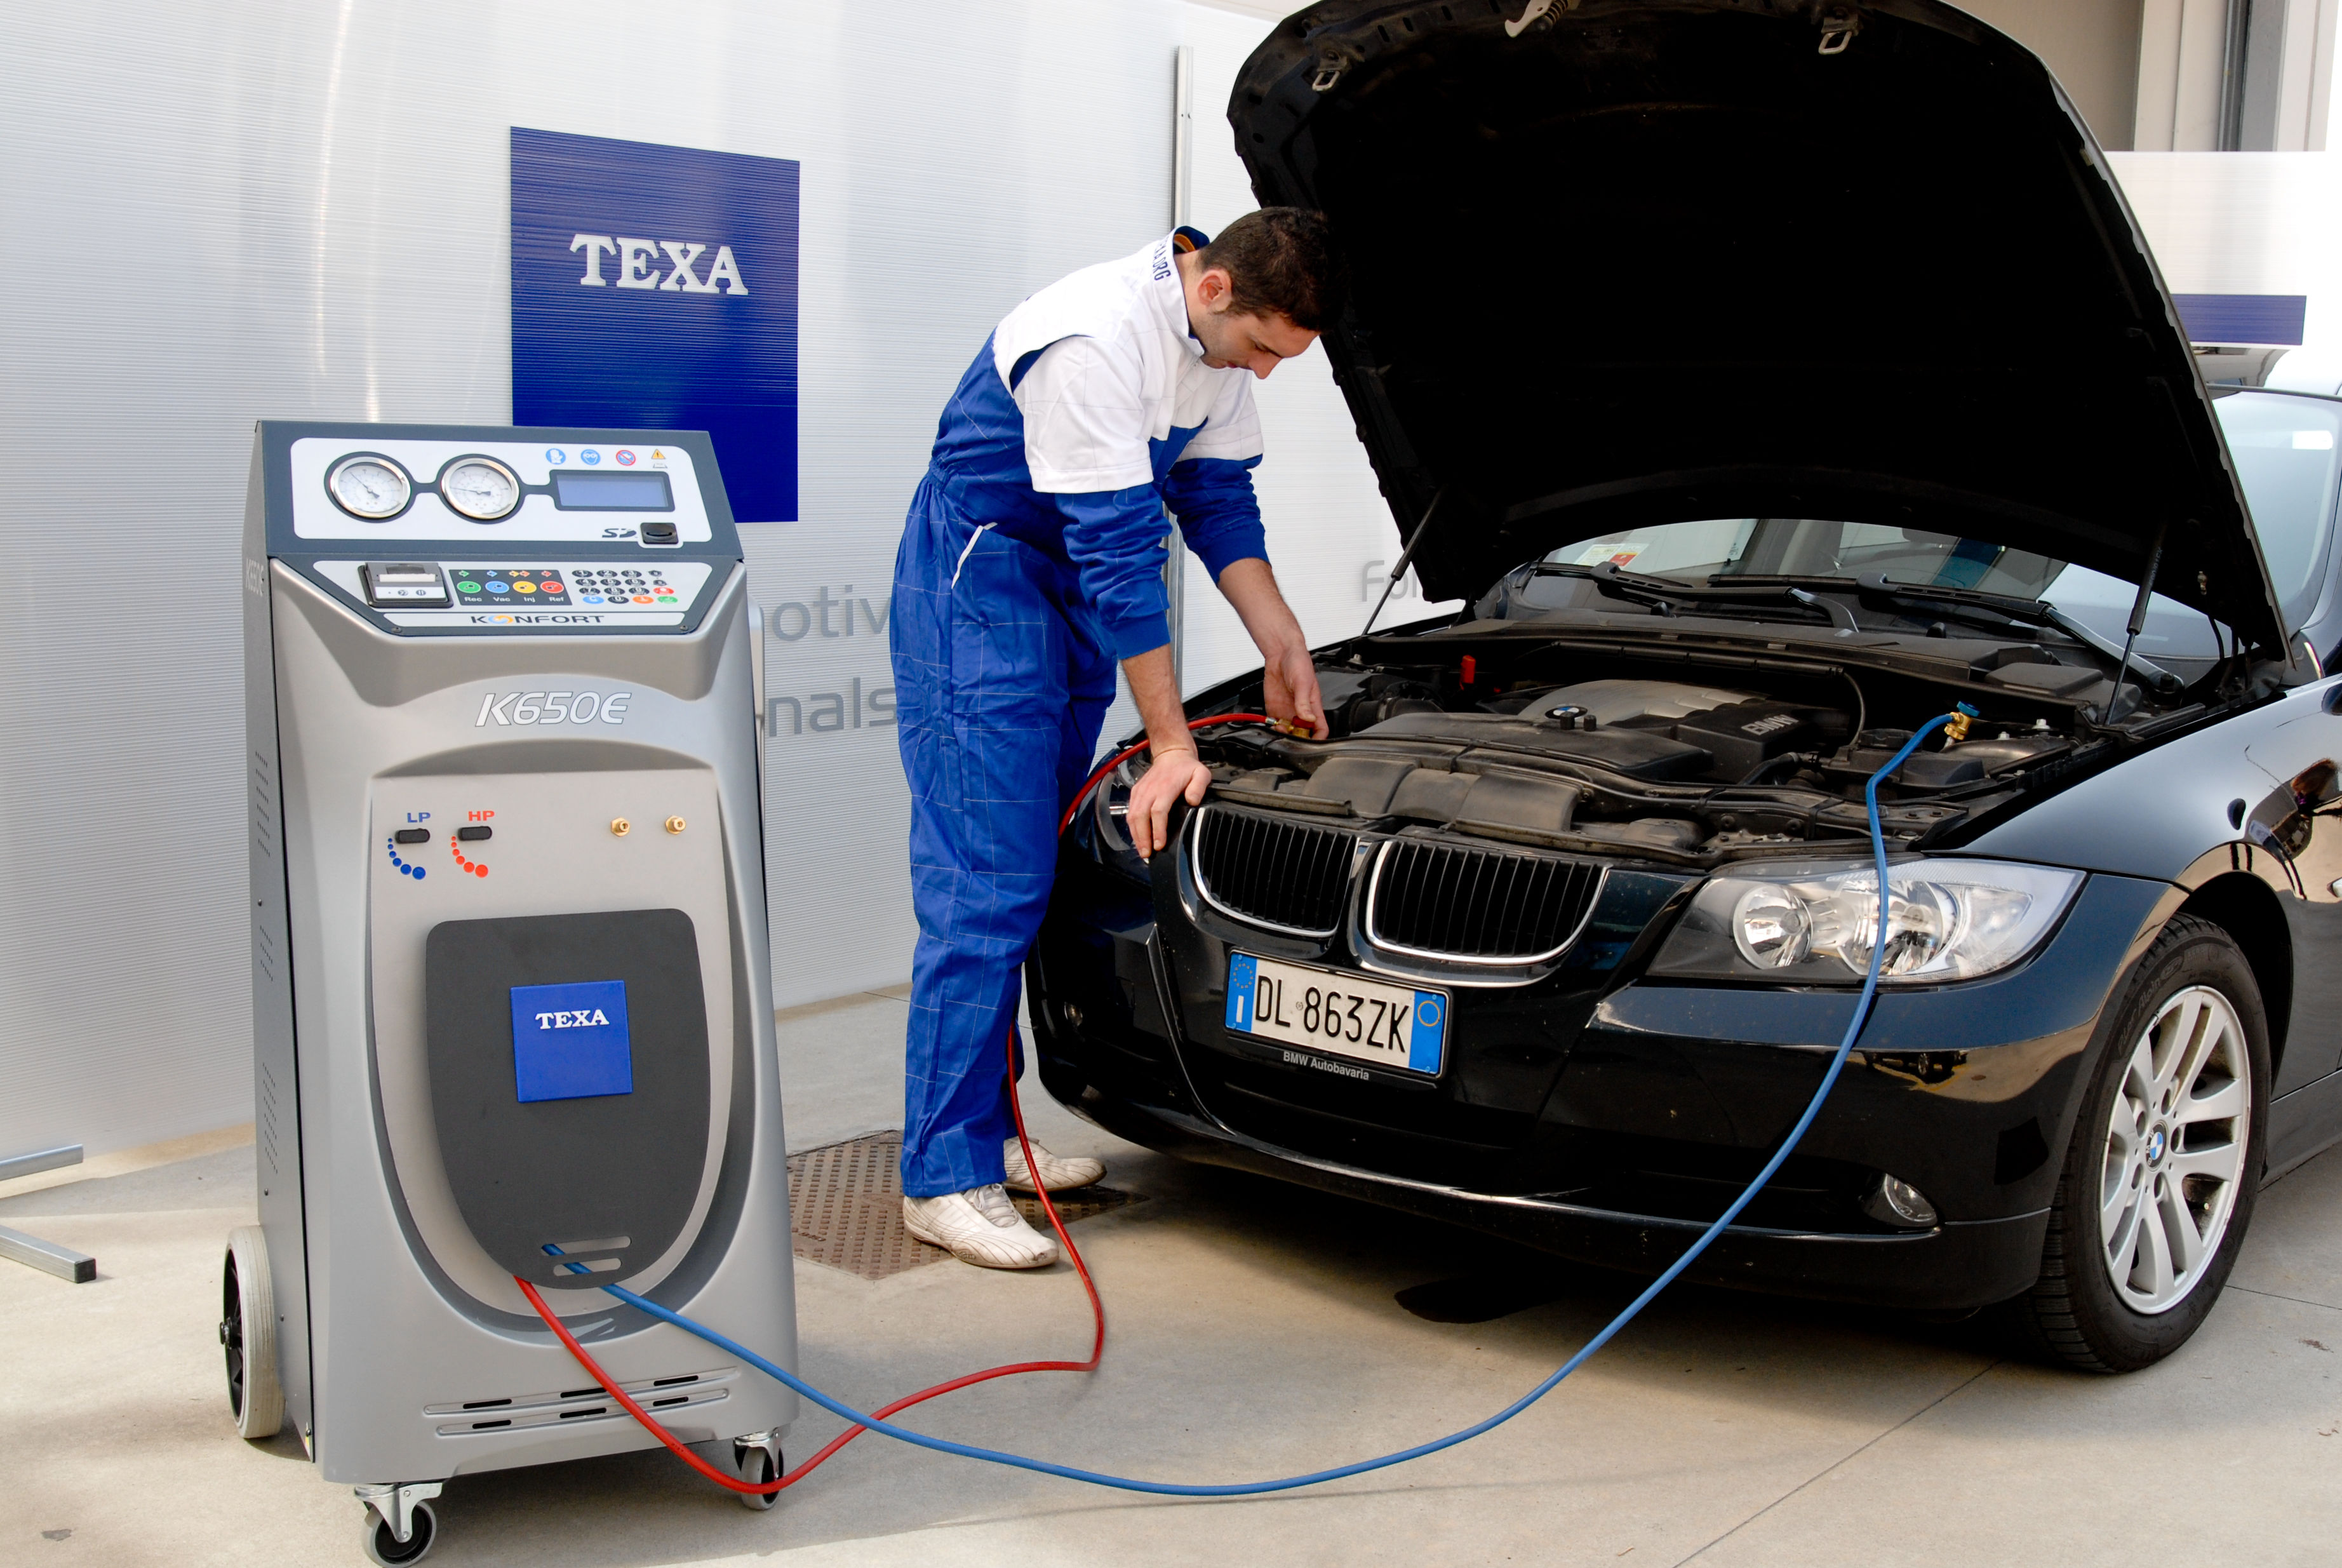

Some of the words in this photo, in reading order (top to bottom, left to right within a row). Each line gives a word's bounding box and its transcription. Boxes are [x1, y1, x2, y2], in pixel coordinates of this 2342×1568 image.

[569, 233, 749, 295] TEXA
[471, 615, 605, 624] KONFORT
[475, 691, 632, 727] K650E
[768, 677, 897, 737] nals
[1741, 714, 1800, 736] BMW
[406, 812, 431, 823] LP
[467, 810, 495, 822] HP
[535, 1009, 610, 1029] TEXA
[1255, 975, 1290, 1028] DL
[1304, 986, 1410, 1053] 863ZK
[1283, 1051, 1308, 1066] BMW
[1310, 1057, 1369, 1080] Autobavaria
